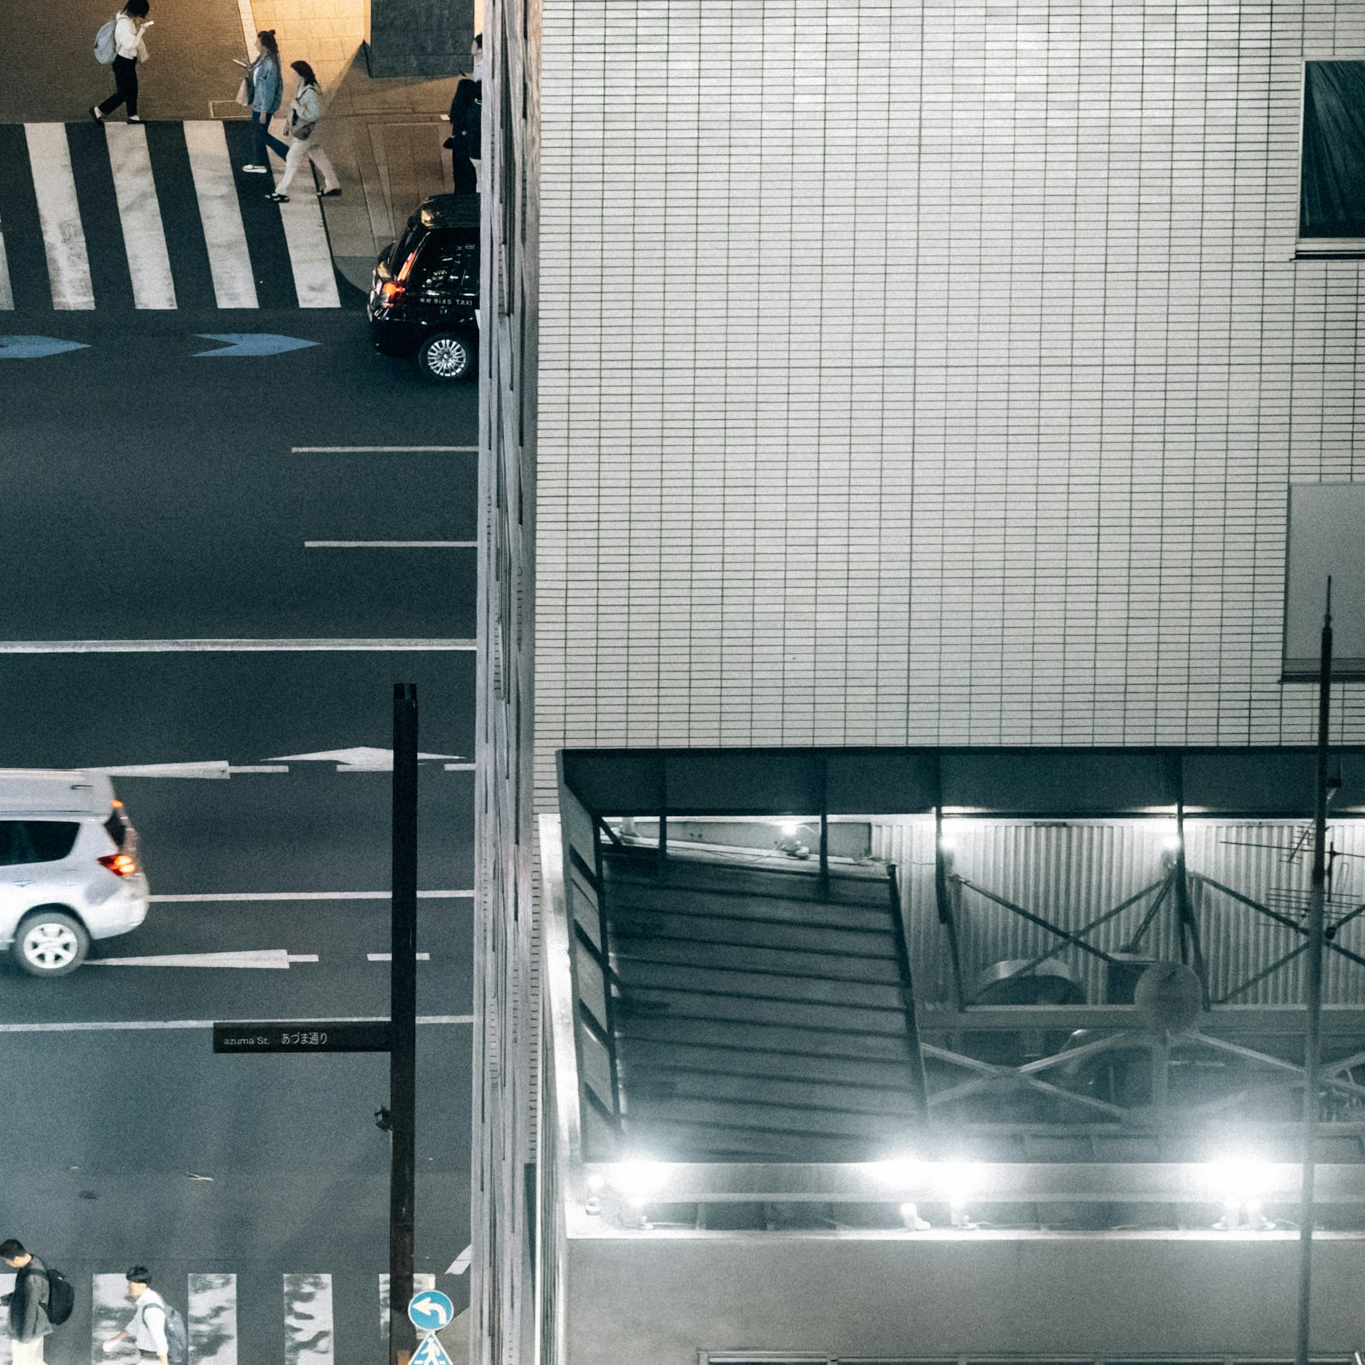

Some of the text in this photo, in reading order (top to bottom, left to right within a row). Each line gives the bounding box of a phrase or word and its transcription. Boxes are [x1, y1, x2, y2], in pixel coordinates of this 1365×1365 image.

[223, 1036, 270, 1045] azuma St.
[281, 1031, 328, 1045] あづま通り
